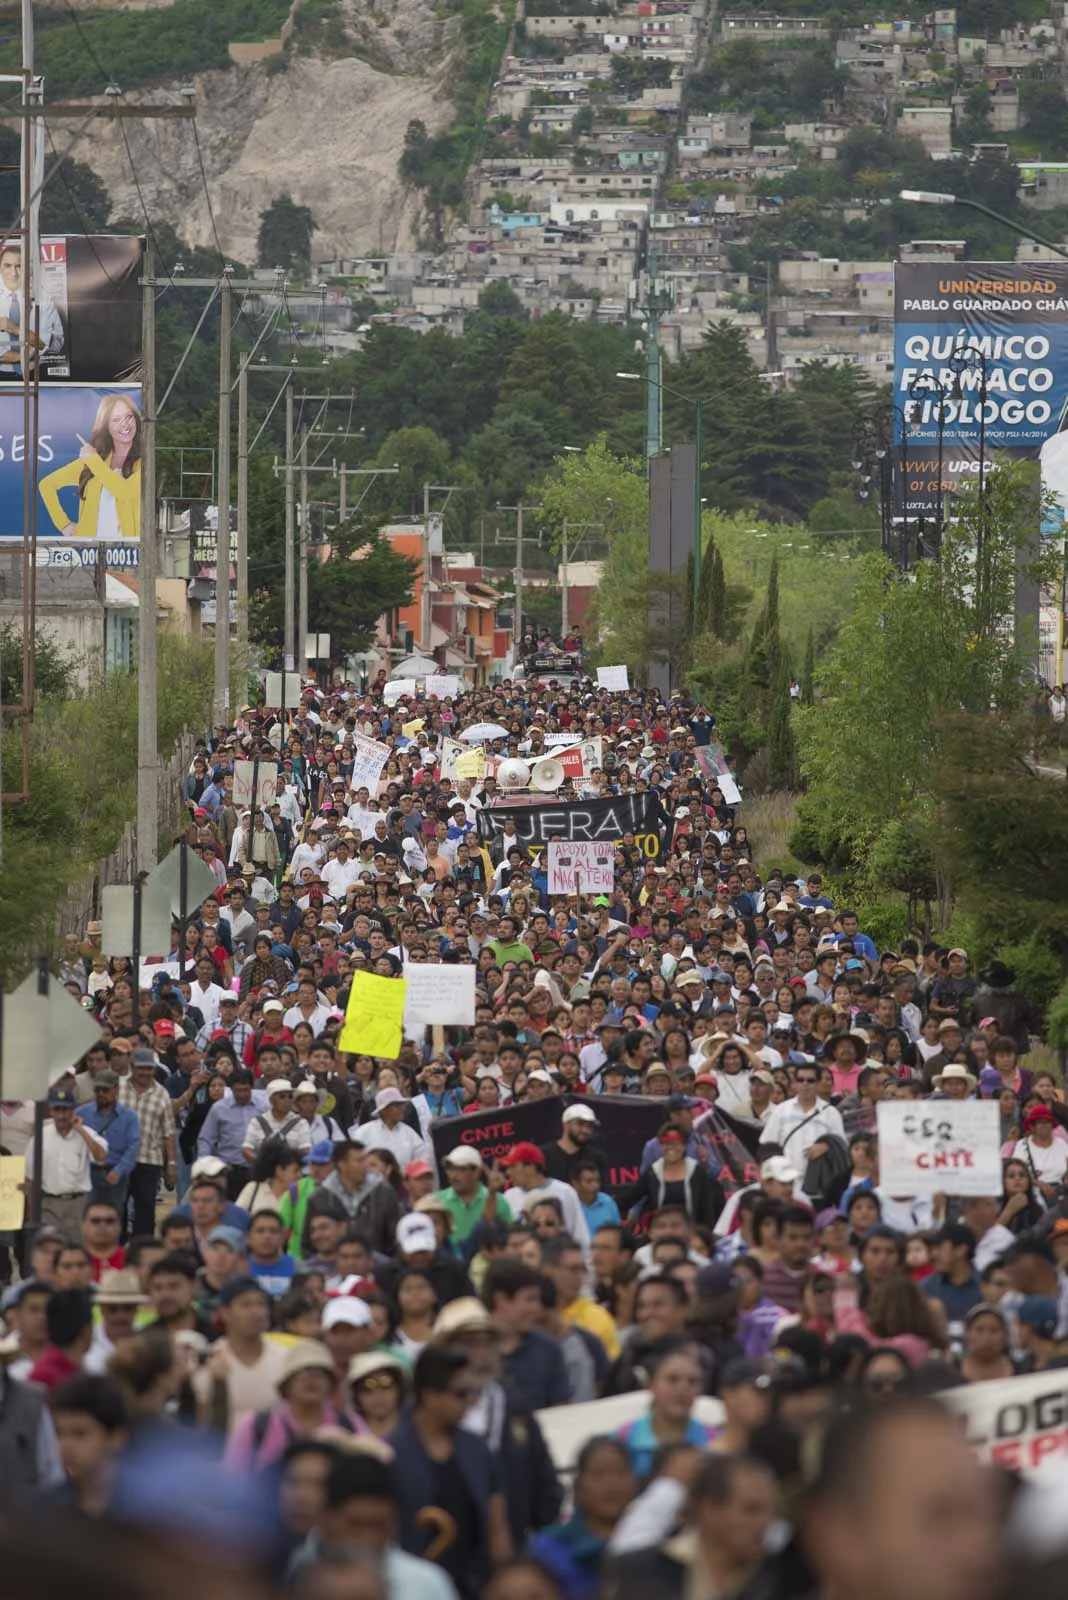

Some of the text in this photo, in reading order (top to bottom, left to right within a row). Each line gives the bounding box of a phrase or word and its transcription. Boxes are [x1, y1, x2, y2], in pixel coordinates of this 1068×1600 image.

[938, 280, 1057, 294] UNIVERSIDAD
[903, 299, 949, 311] PABLO
[952, 299, 1033, 311] GUARDADO
[904, 328, 1050, 362] QUÍMICO
[0, 435, 54, 462] ES
[901, 501, 933, 510] UXTLA
[555, 843, 587, 857] APOYO
[574, 856, 600, 872] AL
[460, 1121, 516, 1144] CNTE
[914, 1151, 975, 1170] CNTE
